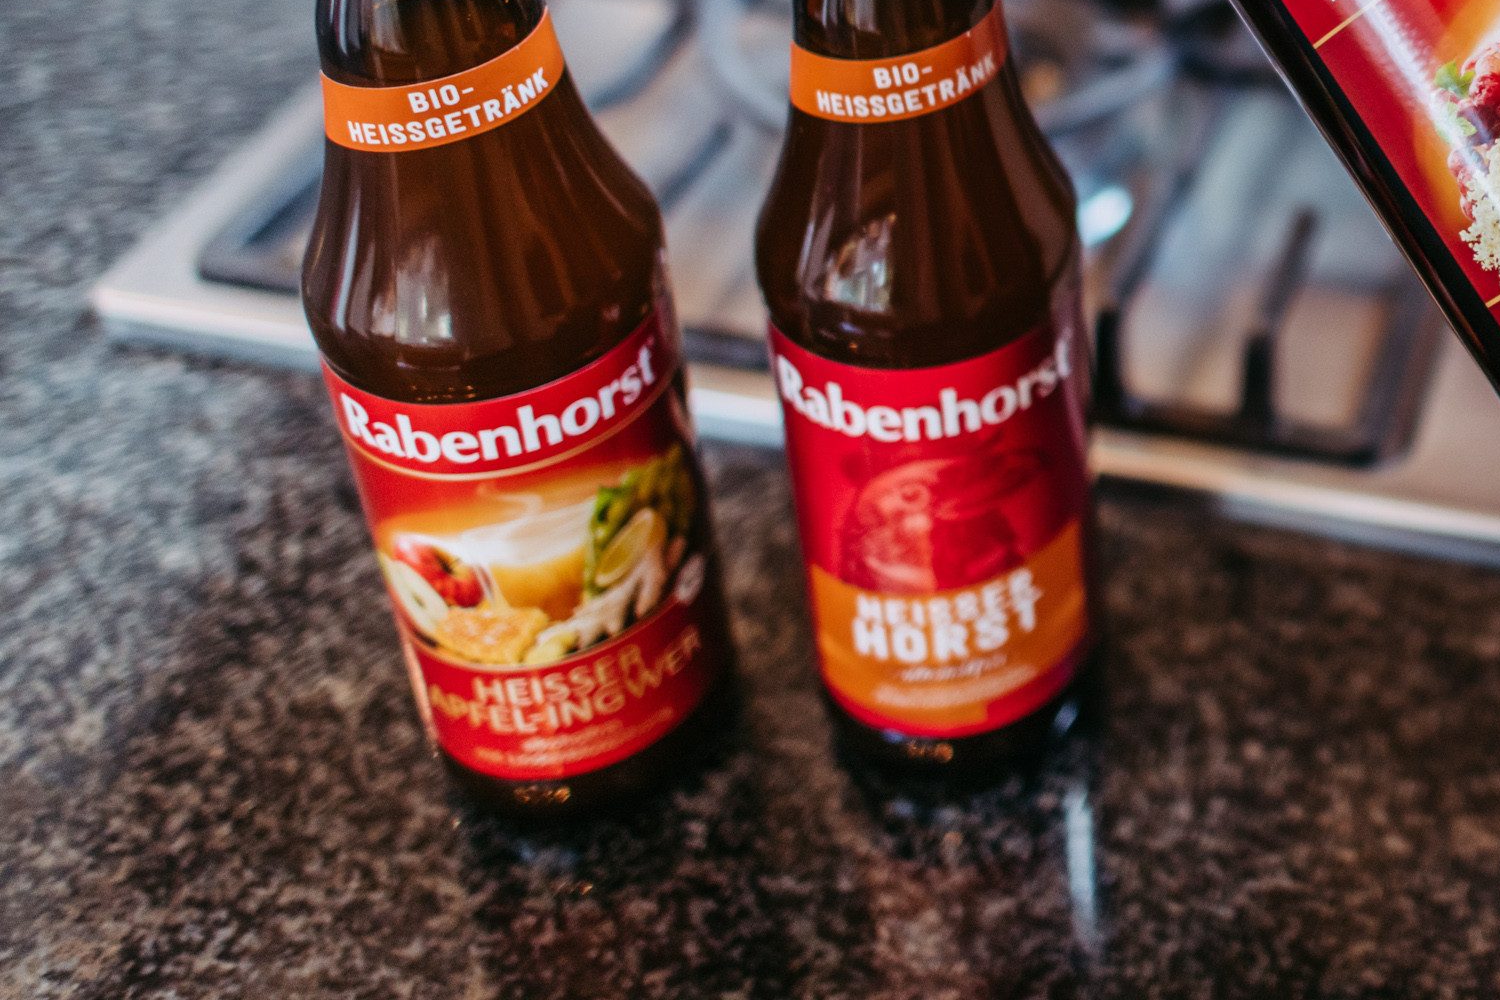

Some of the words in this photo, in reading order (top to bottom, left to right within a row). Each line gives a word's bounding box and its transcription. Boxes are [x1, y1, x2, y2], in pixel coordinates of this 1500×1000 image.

[347, 66, 549, 145] HEISSGETRÄNK
[407, 83, 475, 114] BIO-
[816, 53, 996, 118] HEISSGETRÄNK
[873, 62, 933, 90] BIO-
[340, 344, 656, 464] Rabenhorst
[777, 337, 1071, 443] Rabenhorst
